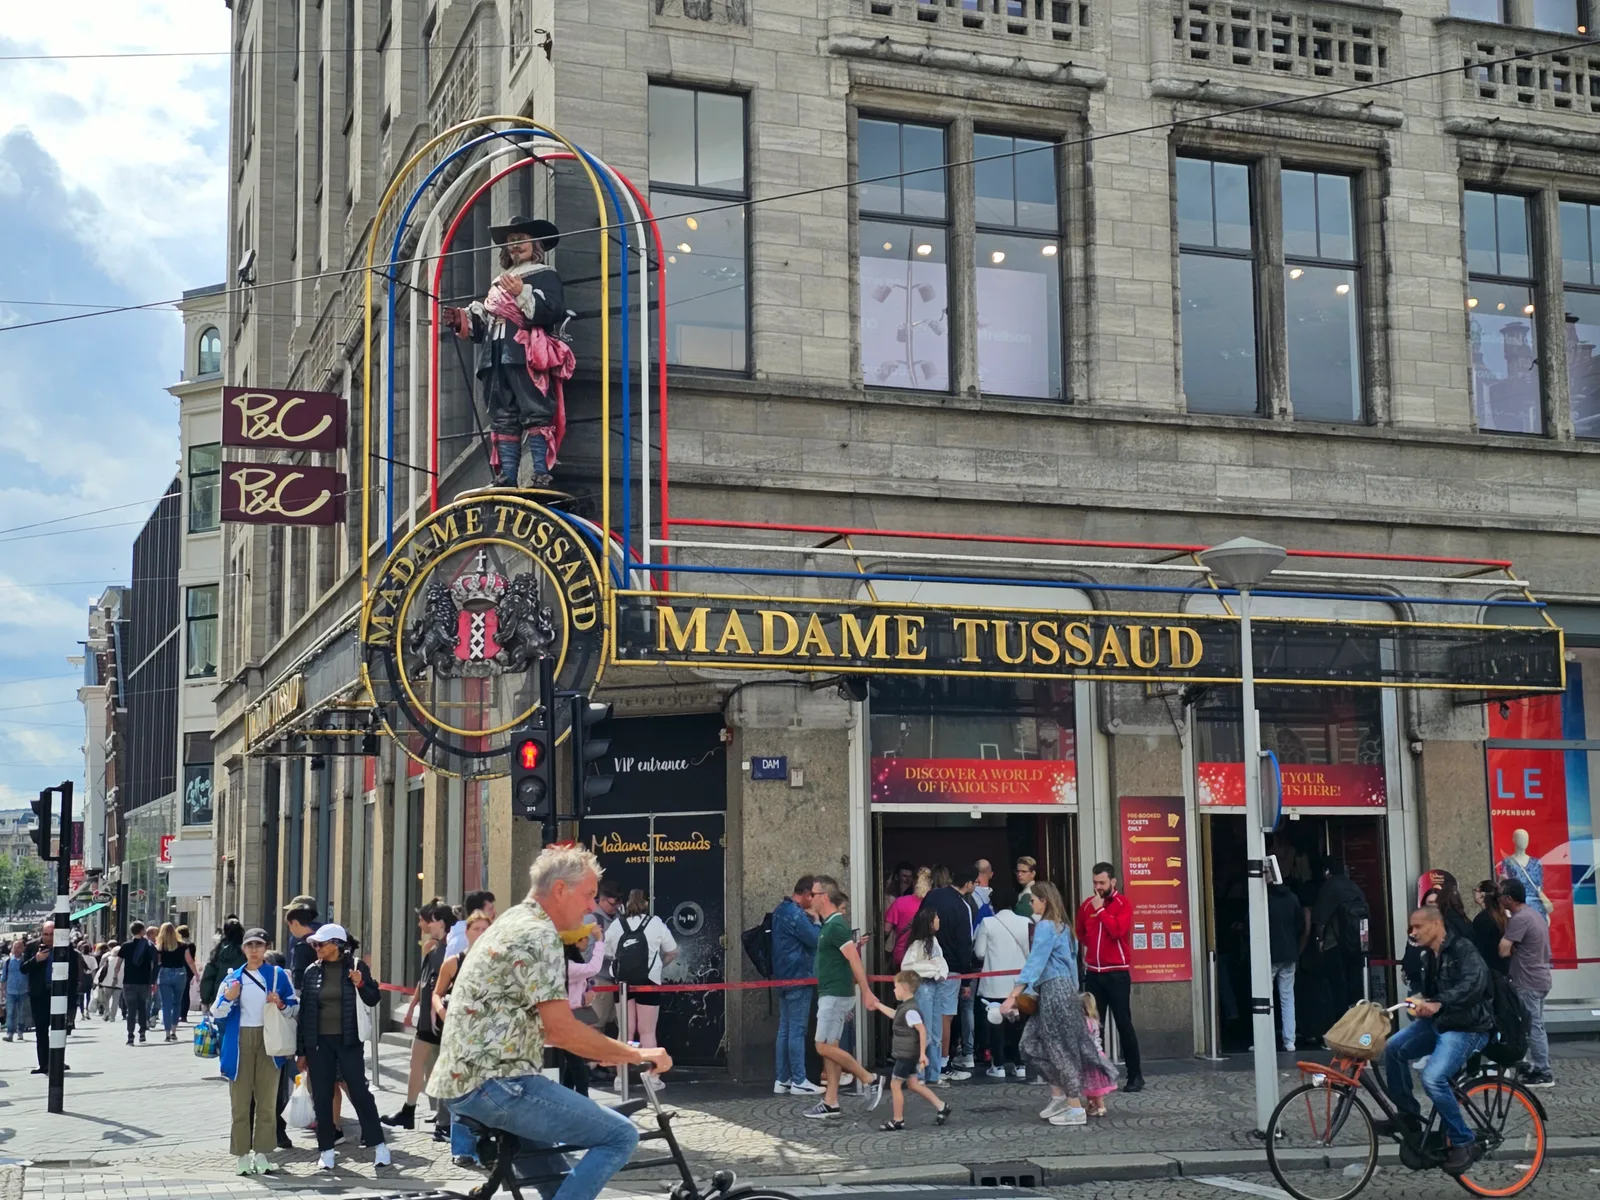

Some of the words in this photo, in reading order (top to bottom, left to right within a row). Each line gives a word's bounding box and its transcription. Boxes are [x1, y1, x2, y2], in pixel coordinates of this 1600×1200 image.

[368, 505, 483, 646] MADAME
[494, 505, 597, 632] TUSSAUD
[656, 605, 928, 660] MADAME
[953, 617, 1204, 669] TUSSAUD
[614, 757, 635, 773] VIP
[638, 757, 690, 772] entrance
[762, 759, 780, 769] DAM
[905, 767, 975, 780] DISCOVER
[979, 768, 989, 780] A
[991, 768, 1043, 781] WORLD
[1289, 772, 1326, 784] YOUR
[917, 781, 938, 793] OF
[940, 781, 999, 793] FAMOUS
[1001, 782, 1031, 794] FUN
[1303, 784, 1341, 797] HERE!
[592, 832, 650, 854] Madame
[647, 831, 711, 852] Tussauds
[625, 855, 676, 864] AMSTERDAM
